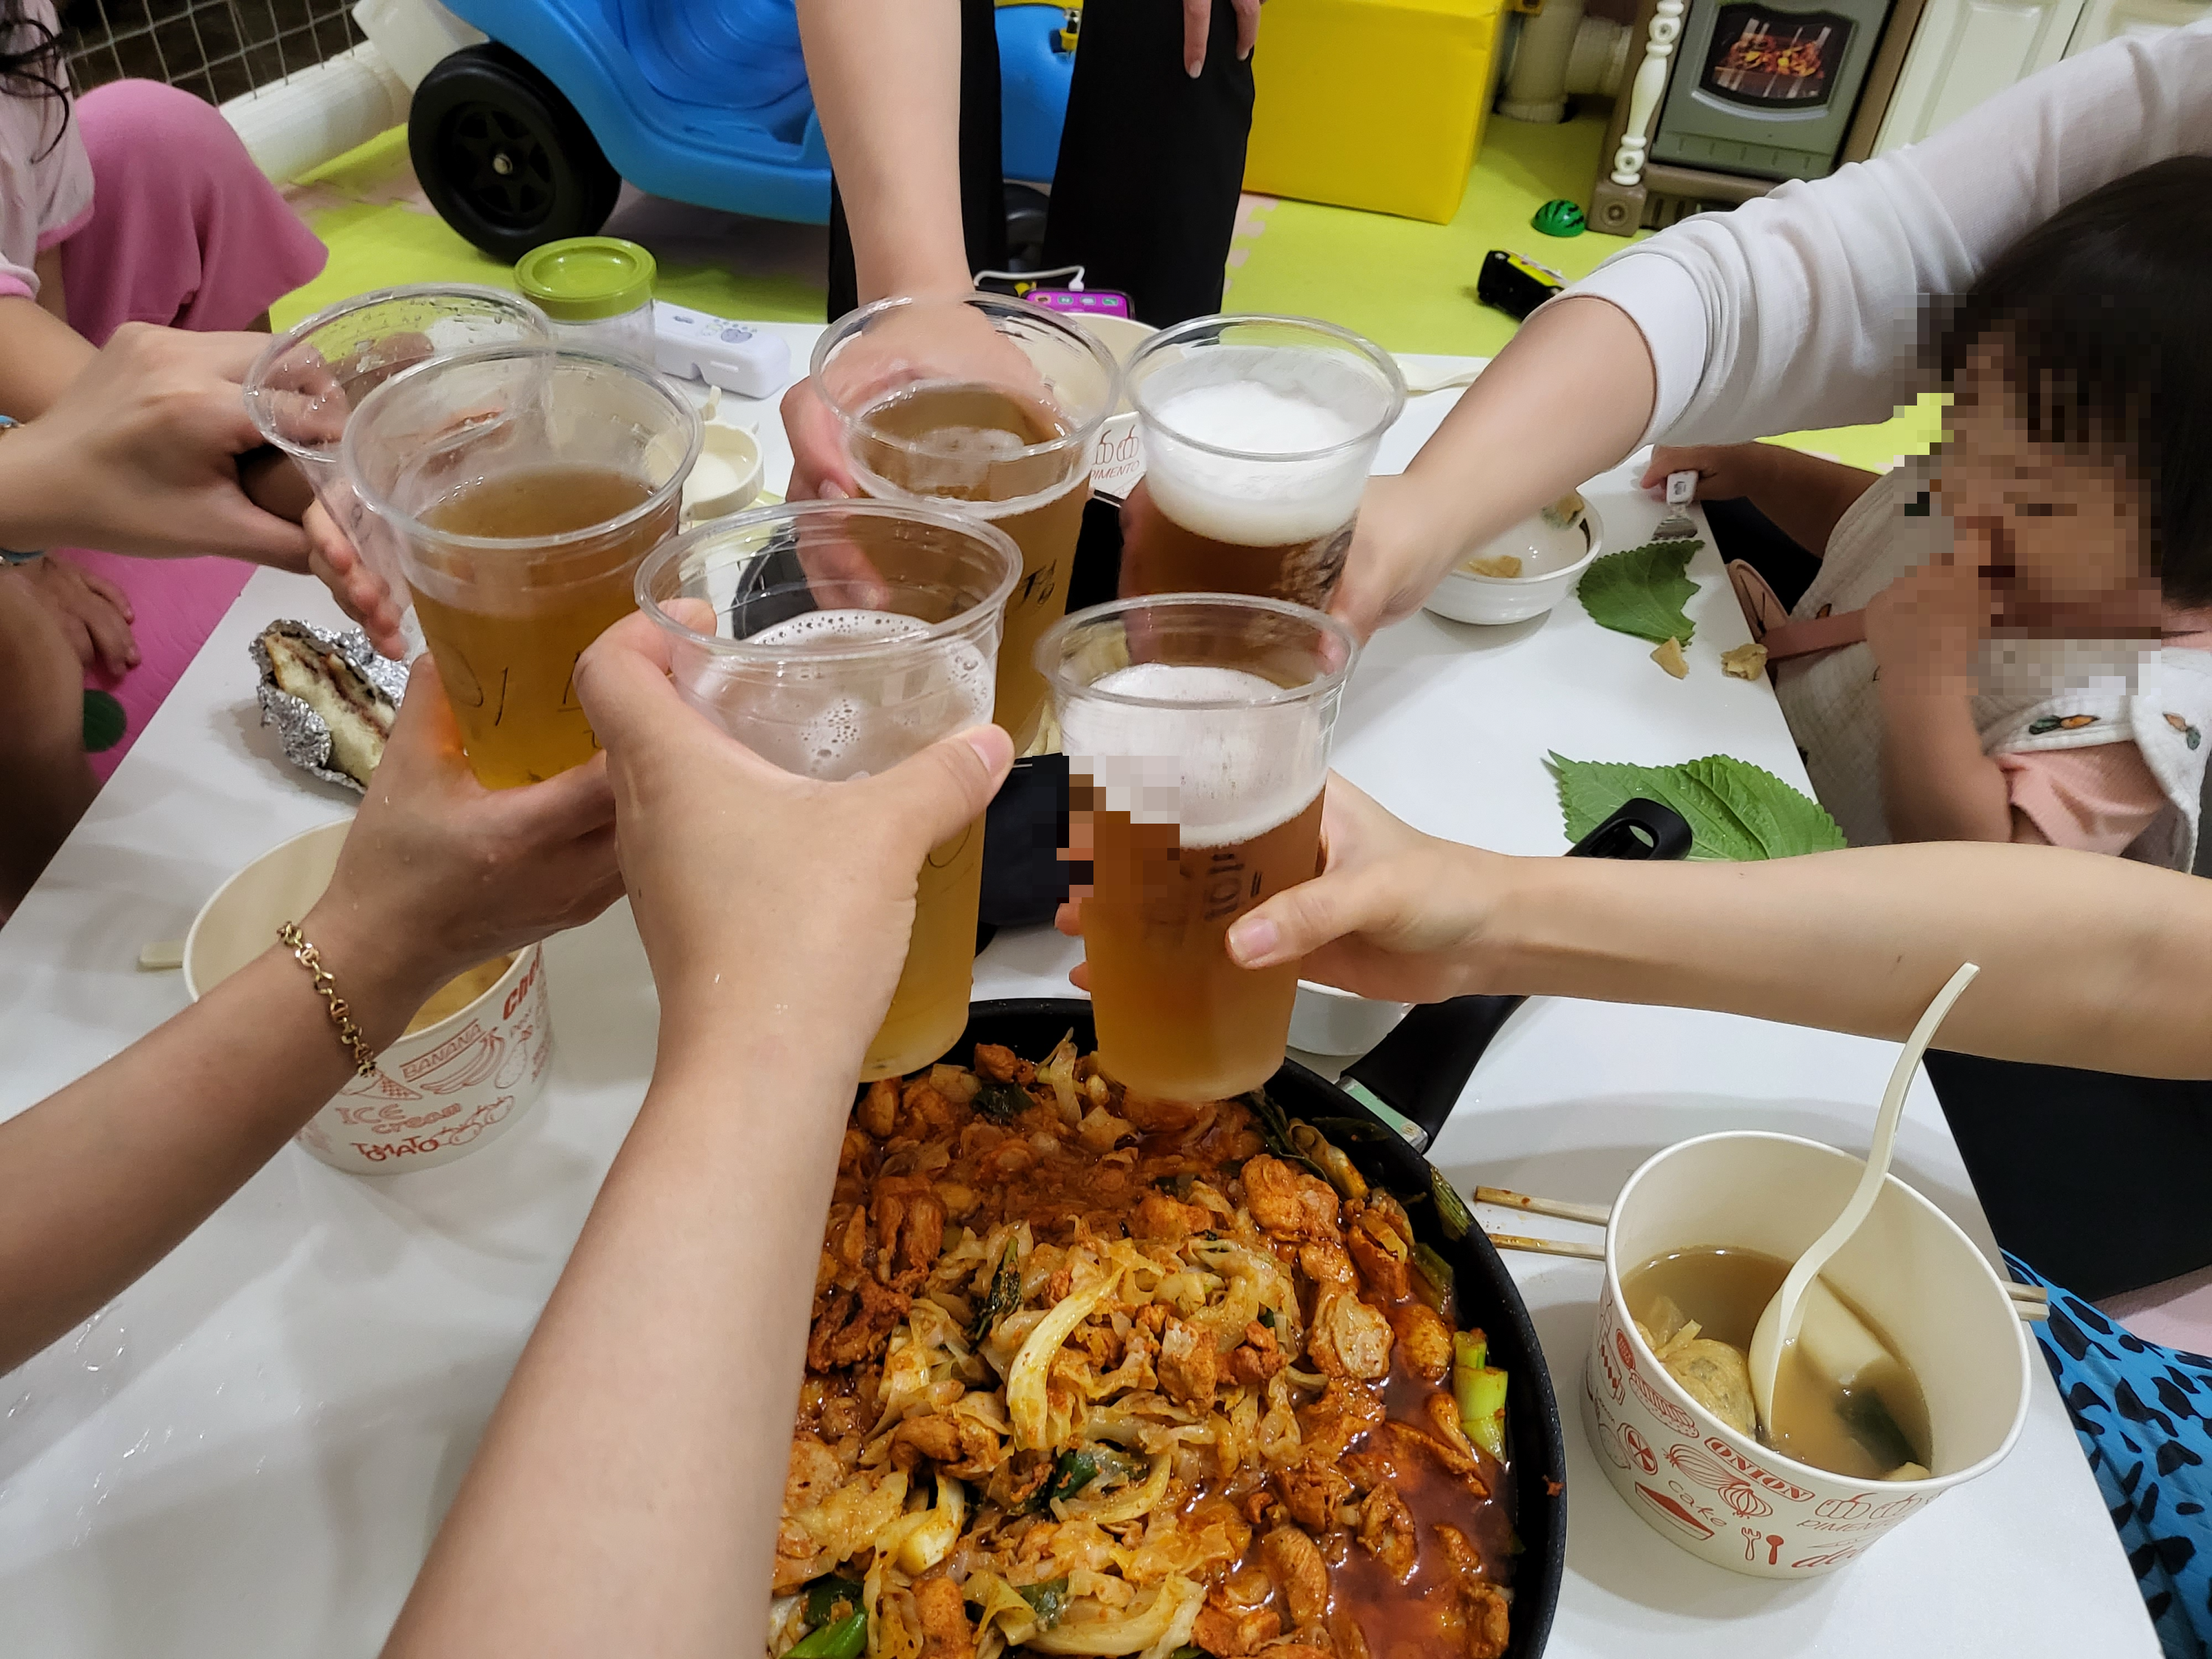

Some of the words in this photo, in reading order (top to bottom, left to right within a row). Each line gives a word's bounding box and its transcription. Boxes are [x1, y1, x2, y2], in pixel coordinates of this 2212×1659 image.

[1091, 459, 1140, 480] PIMENTO
[404, 1023, 481, 1077] BANANA
[335, 1103, 406, 1124] ICE
[350, 1135, 439, 1161] TOMATO
[1710, 1441, 1809, 1500] ONION
